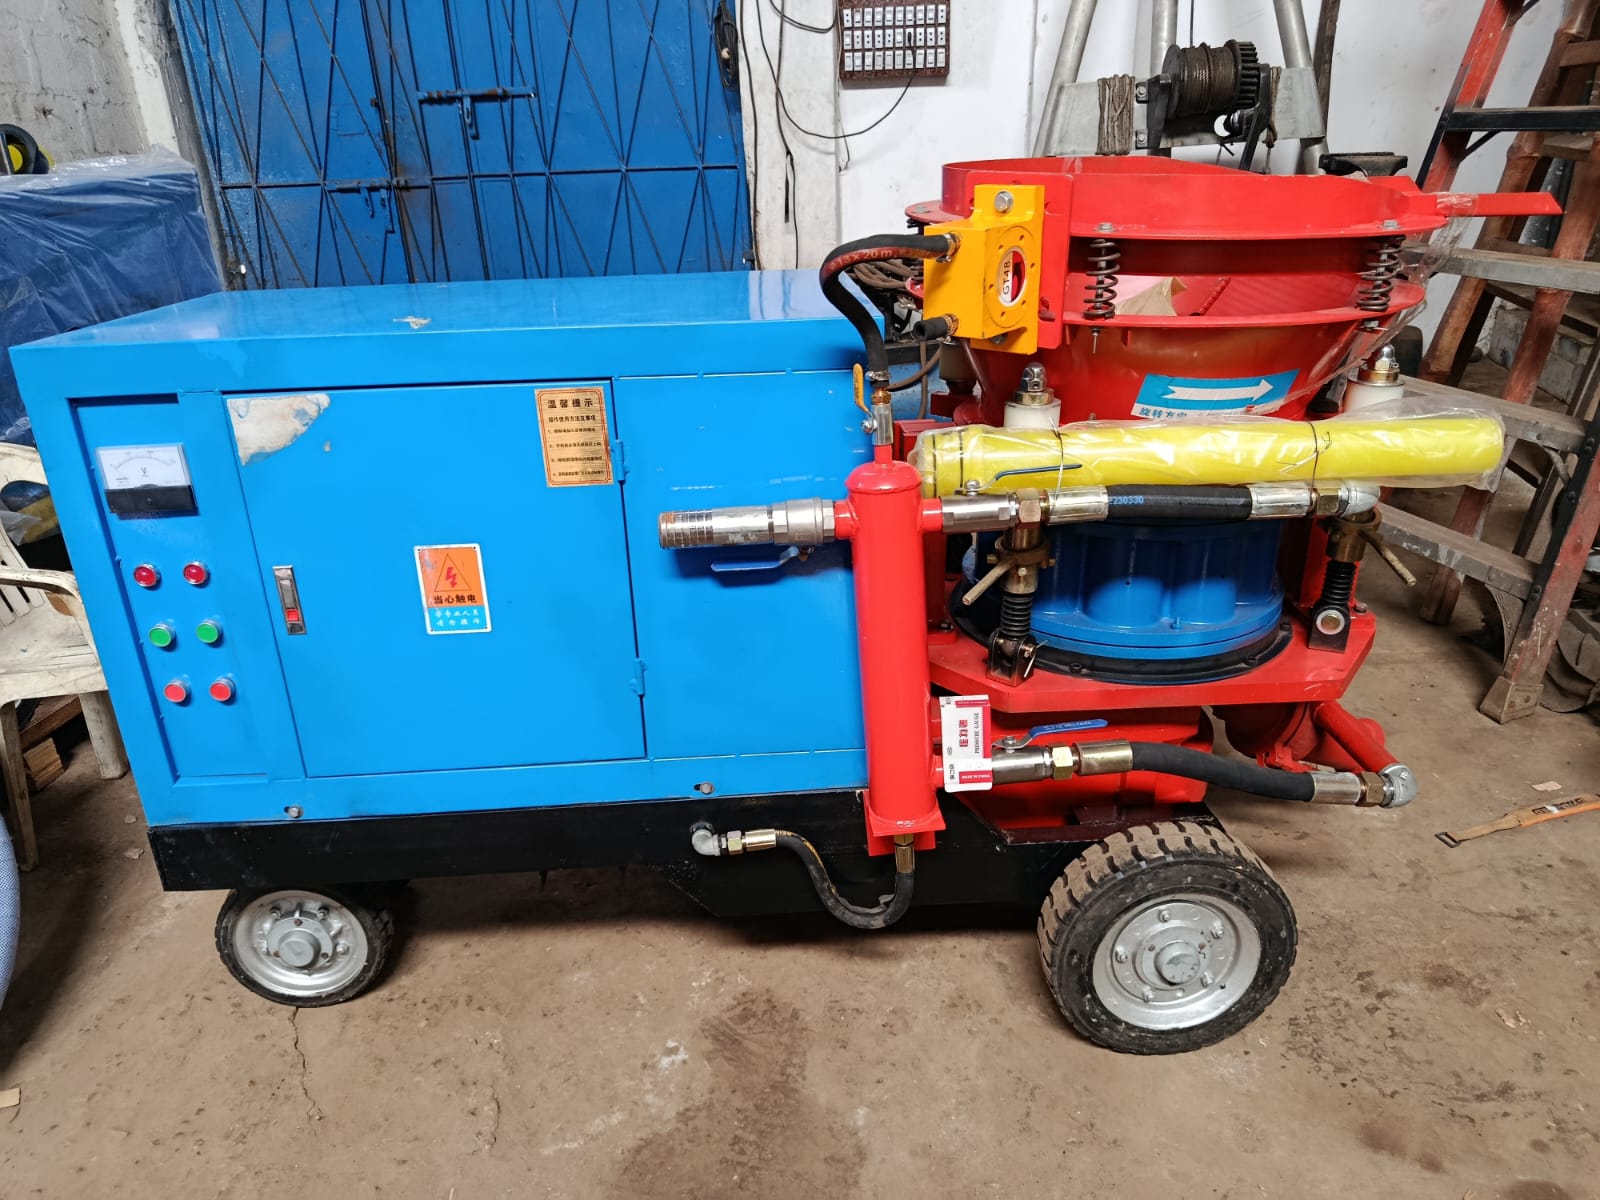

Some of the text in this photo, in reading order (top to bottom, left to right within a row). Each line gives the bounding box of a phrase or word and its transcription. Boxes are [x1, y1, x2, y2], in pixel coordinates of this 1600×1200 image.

[863, 249, 879, 260] 20
[547, 398, 594, 409] 温馨提示
[433, 593, 478, 605] 当心触电
